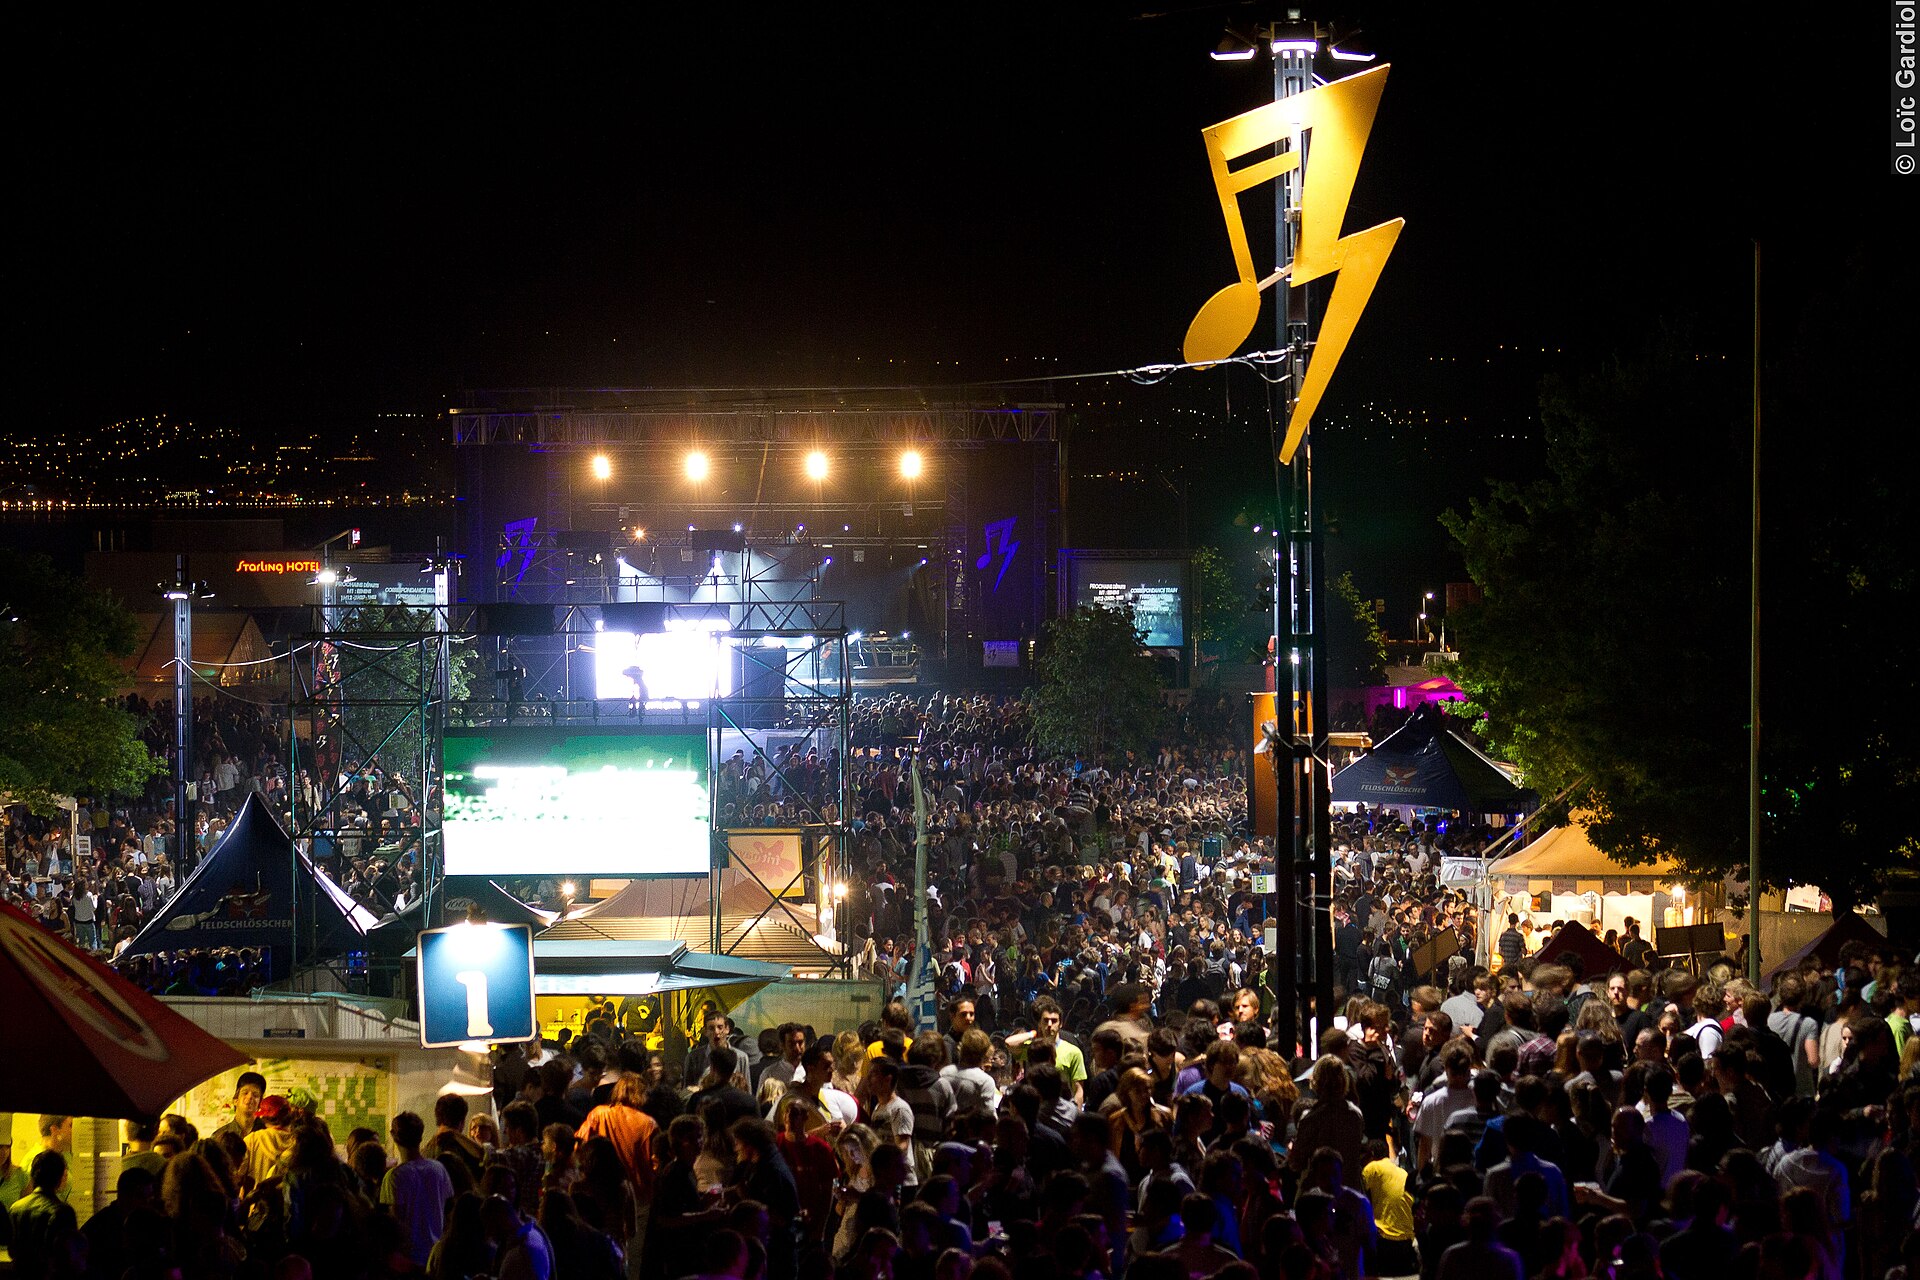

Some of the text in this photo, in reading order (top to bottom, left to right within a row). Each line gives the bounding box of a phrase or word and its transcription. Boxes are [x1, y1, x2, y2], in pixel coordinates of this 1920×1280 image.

[236, 560, 320, 575] Starling HOTEL
[1360, 784, 1427, 794] FELDSCHLÖSSCHEN
